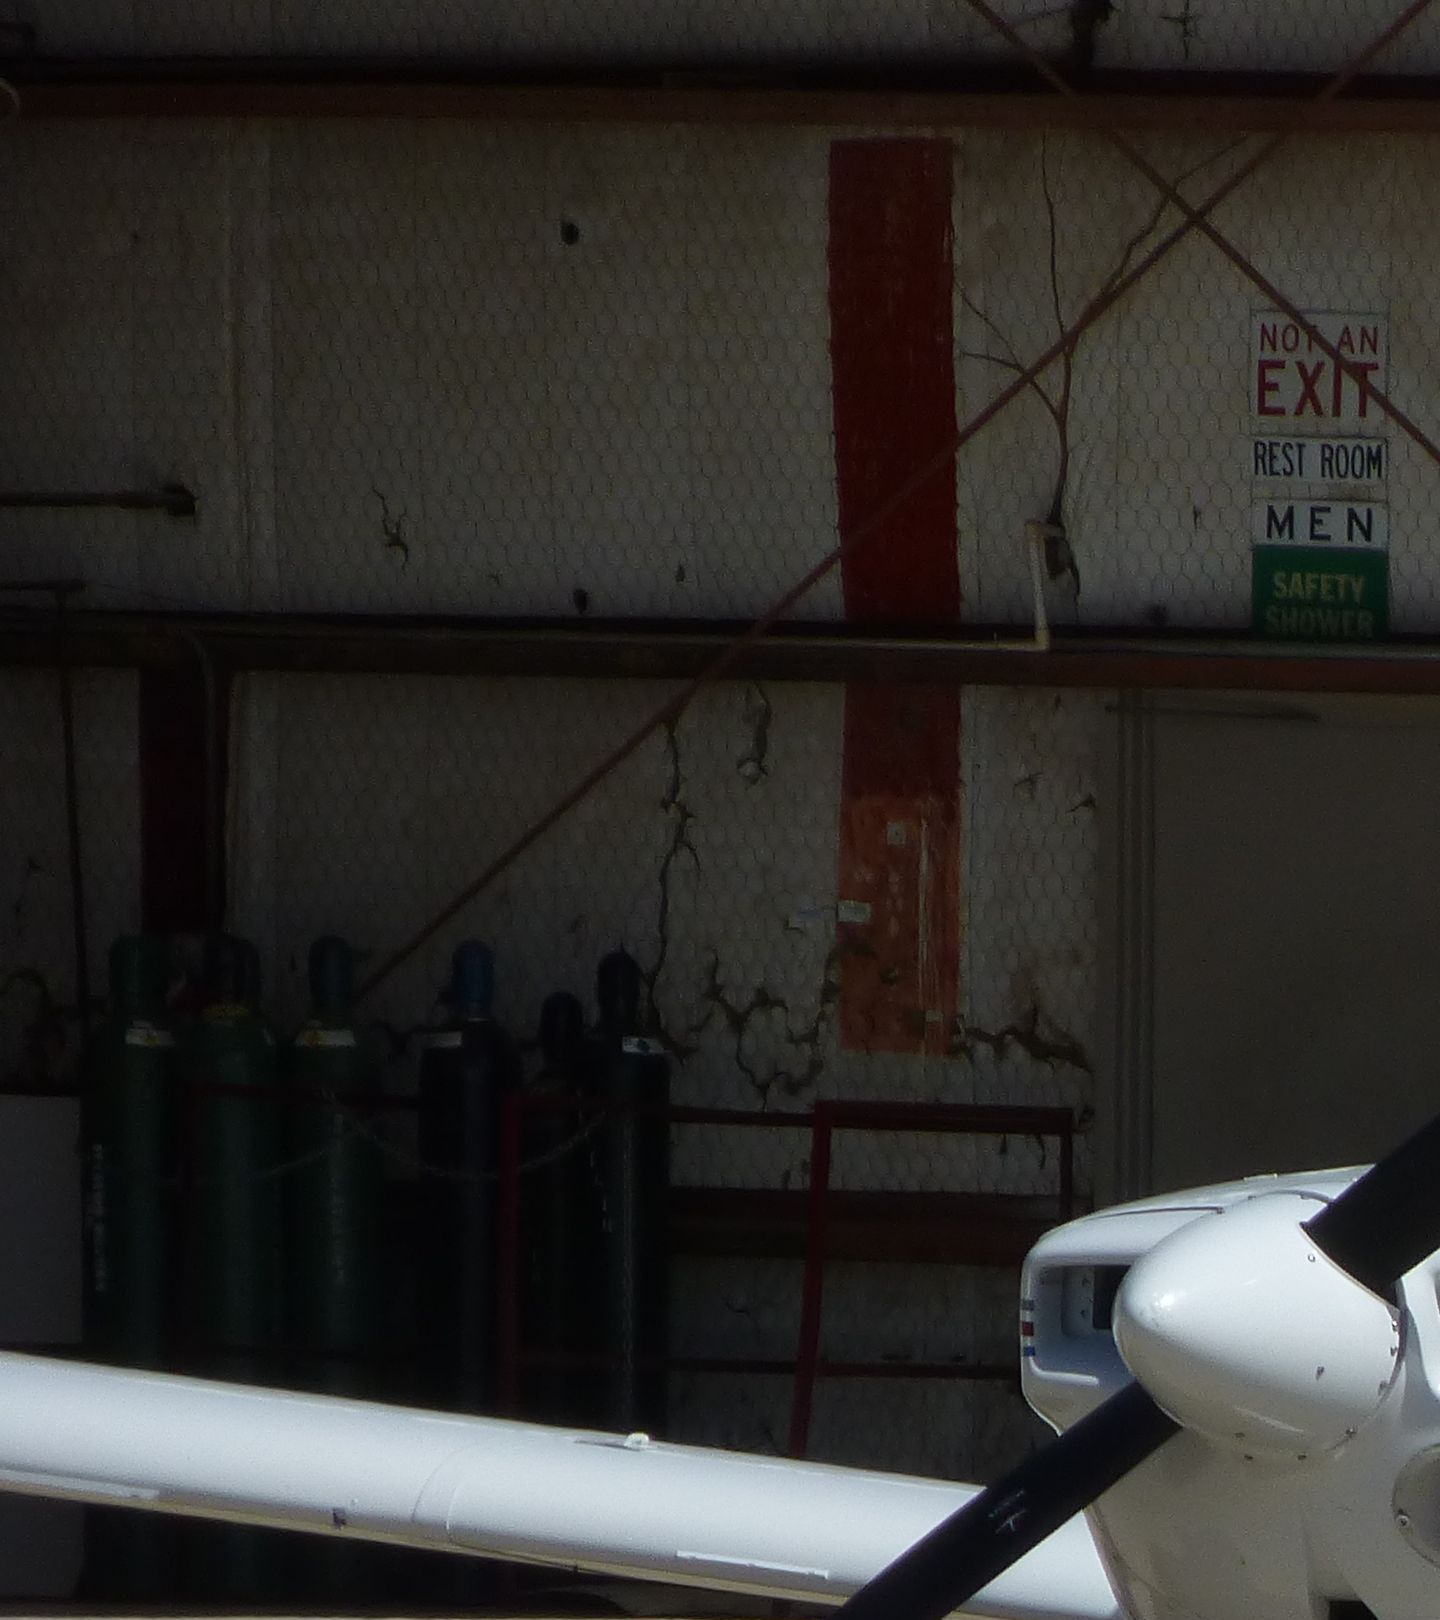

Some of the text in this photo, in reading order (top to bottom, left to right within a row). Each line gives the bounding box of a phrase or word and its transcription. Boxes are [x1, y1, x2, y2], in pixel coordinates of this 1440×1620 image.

[1260, 322, 1379, 354] NOT AN
[1258, 360, 1379, 417] EXIT
[1253, 440, 1383, 479] REST ROOM
[1266, 505, 1373, 543] MEN
[1272, 571, 1365, 605] SAFETY
[1264, 605, 1376, 640] SHOWER
